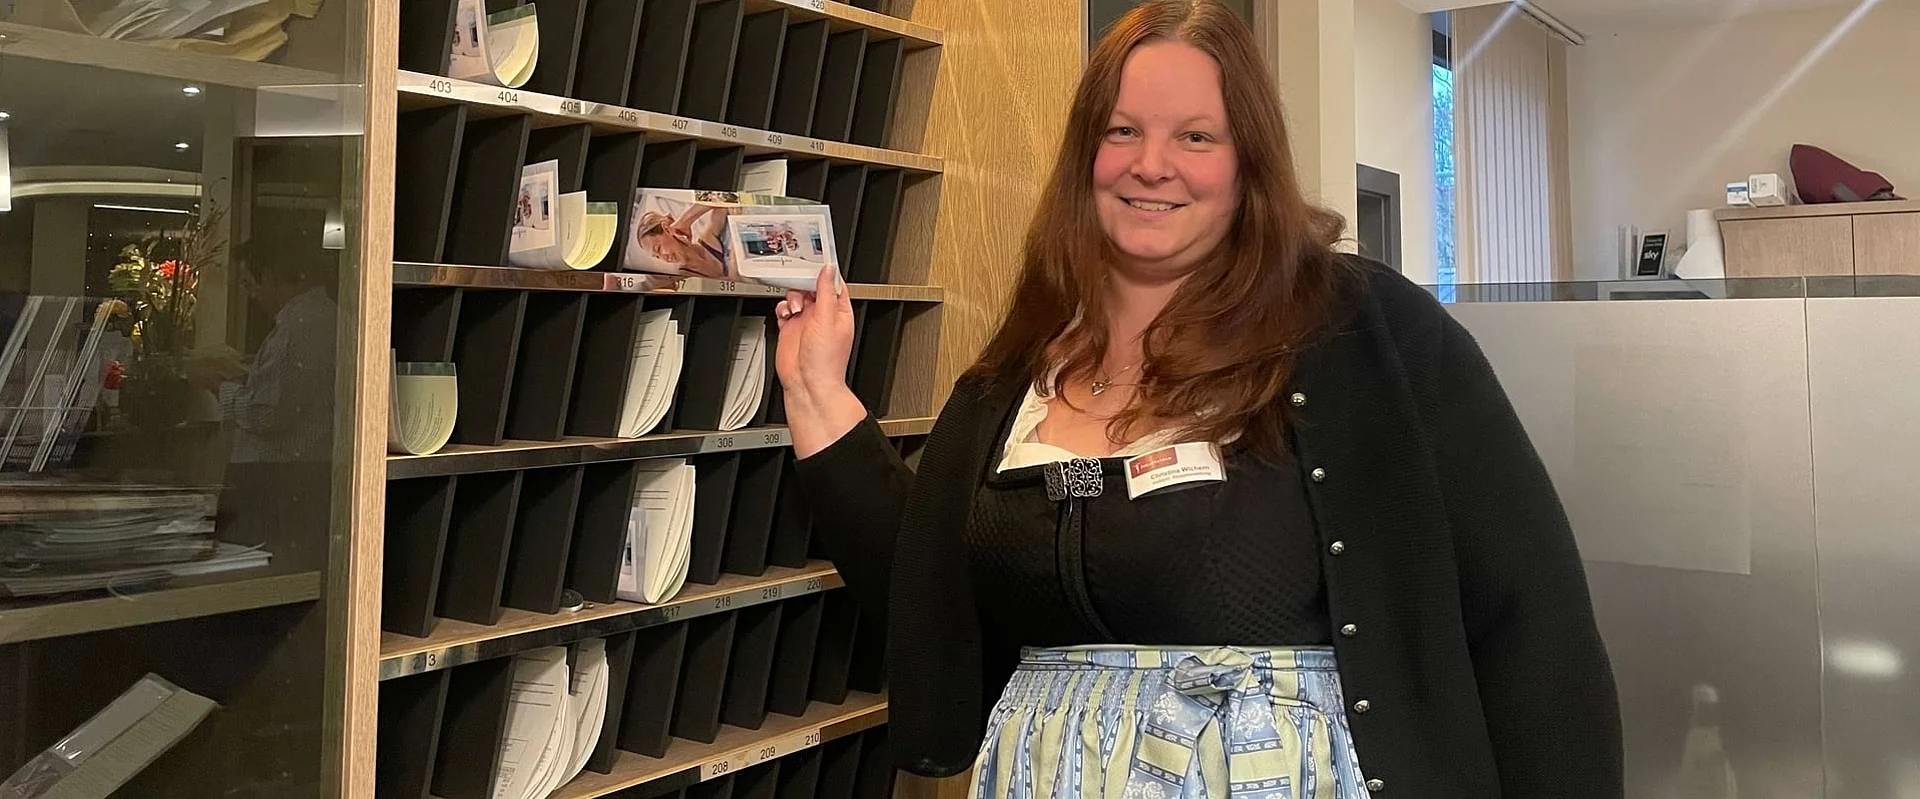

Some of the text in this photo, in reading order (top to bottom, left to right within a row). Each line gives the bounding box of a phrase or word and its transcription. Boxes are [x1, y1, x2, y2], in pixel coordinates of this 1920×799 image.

[811, 0, 825, 10] 420
[429, 80, 825, 151] 403 404 405 406 407 408 409 410
[1643, 250, 1659, 261] sky
[616, 277, 634, 288] 316
[719, 281, 736, 292] 318
[717, 434, 780, 448] 308 309
[1150, 468, 1180, 480] Christina
[663, 606, 681, 618] 217
[715, 596, 731, 609] 218
[762, 587, 778, 600] 219
[807, 579, 821, 591] 220
[712, 732, 819, 775] 208 209 210
